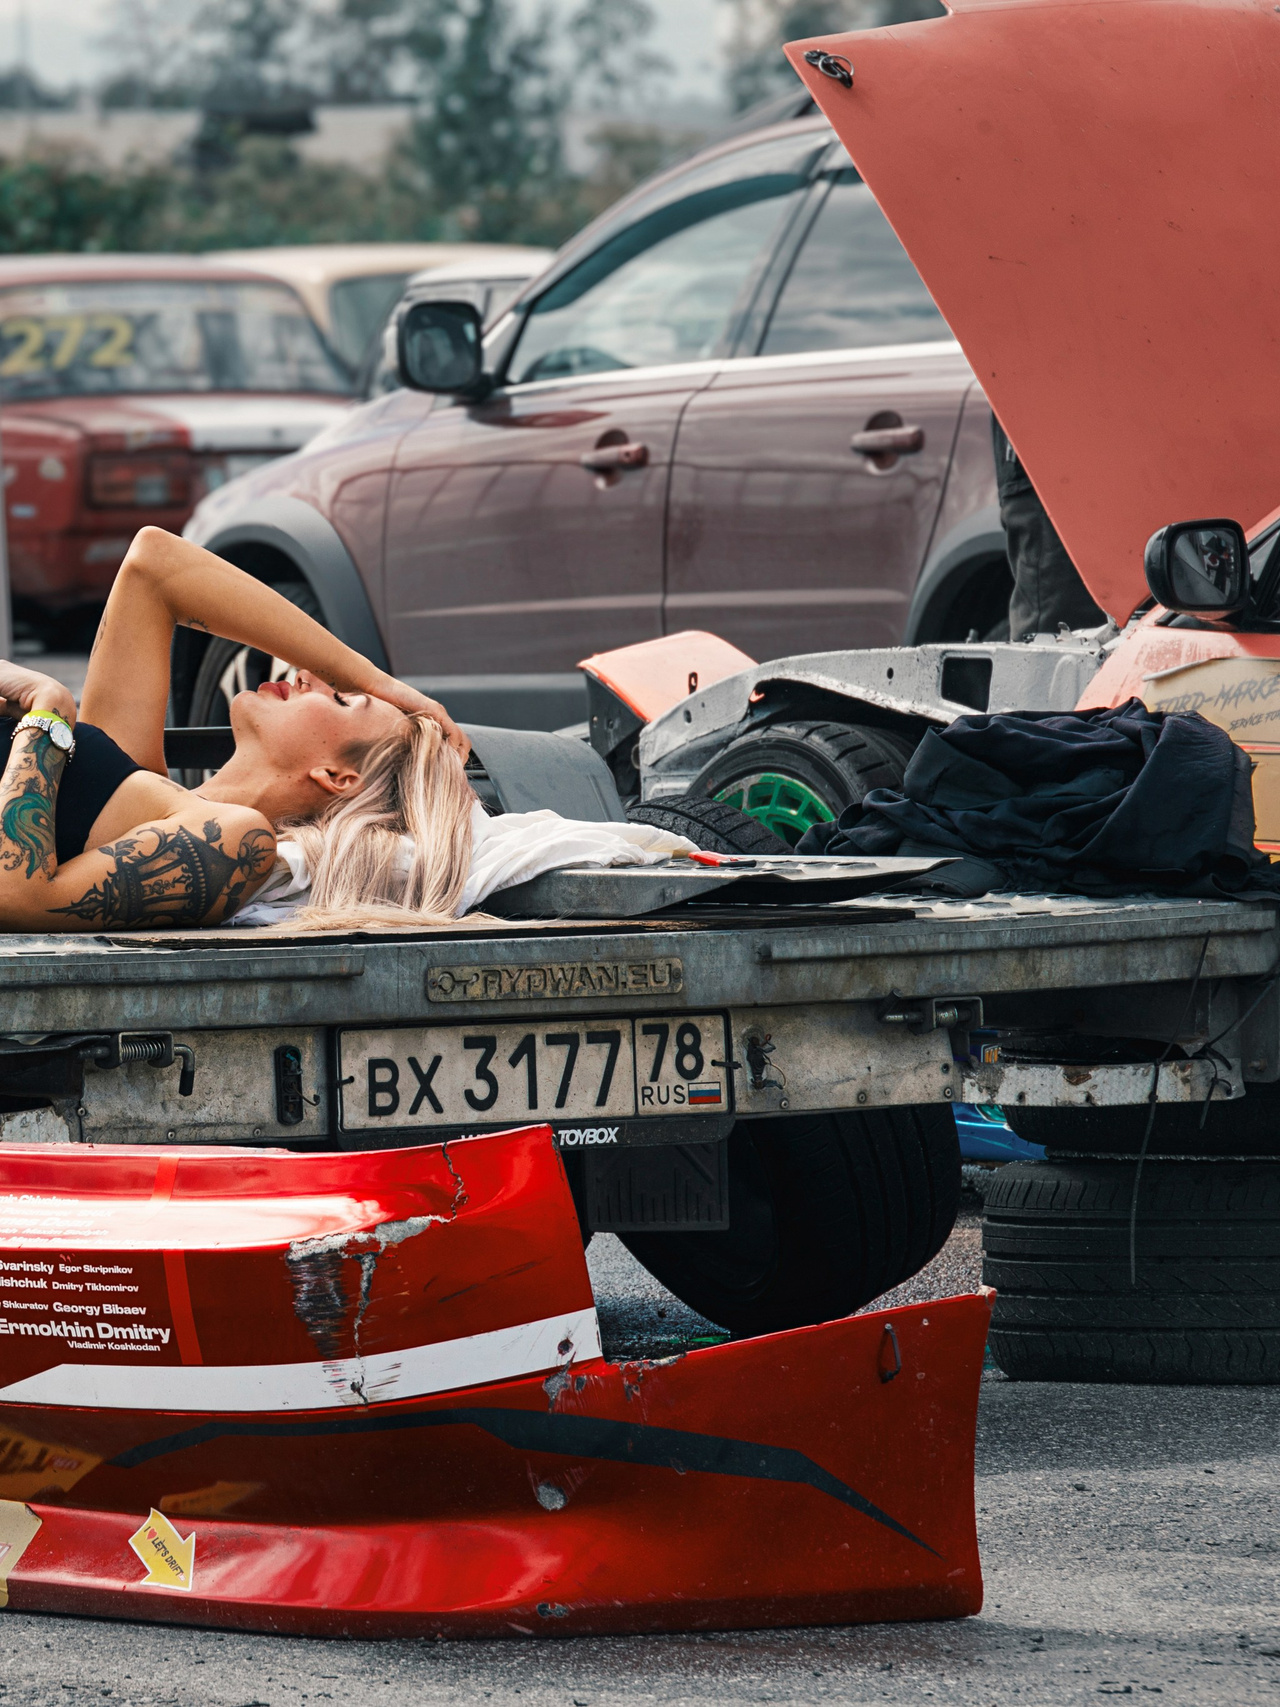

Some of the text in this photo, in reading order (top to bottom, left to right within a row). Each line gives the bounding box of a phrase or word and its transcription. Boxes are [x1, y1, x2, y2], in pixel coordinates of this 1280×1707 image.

[481, 961, 674, 996] RYDWAN.EU
[463, 1030, 621, 1112] 3177
[642, 1022, 705, 1083] 78
[641, 1084, 687, 1107] RUS
[558, 1127, 619, 1147] TOYBOX
[59, 1263, 82, 1274] Egor
[83, 1264, 133, 1275] Skripnikov
[52, 1281, 84, 1292] Dmitry
[85, 1282, 139, 1292] Tikhomirov
[2, 1300, 49, 1311] Shkuratov
[52, 1302, 101, 1316] Georgy
[102, 1303, 147, 1315] Bibaev
[96, 1322, 171, 1344] Dmitry
[67, 1340, 161, 1352] Vladimir Koshkodan
[151, 1537, 170, 1558] LET'S
[164, 1555, 185, 1577] DRIFT
